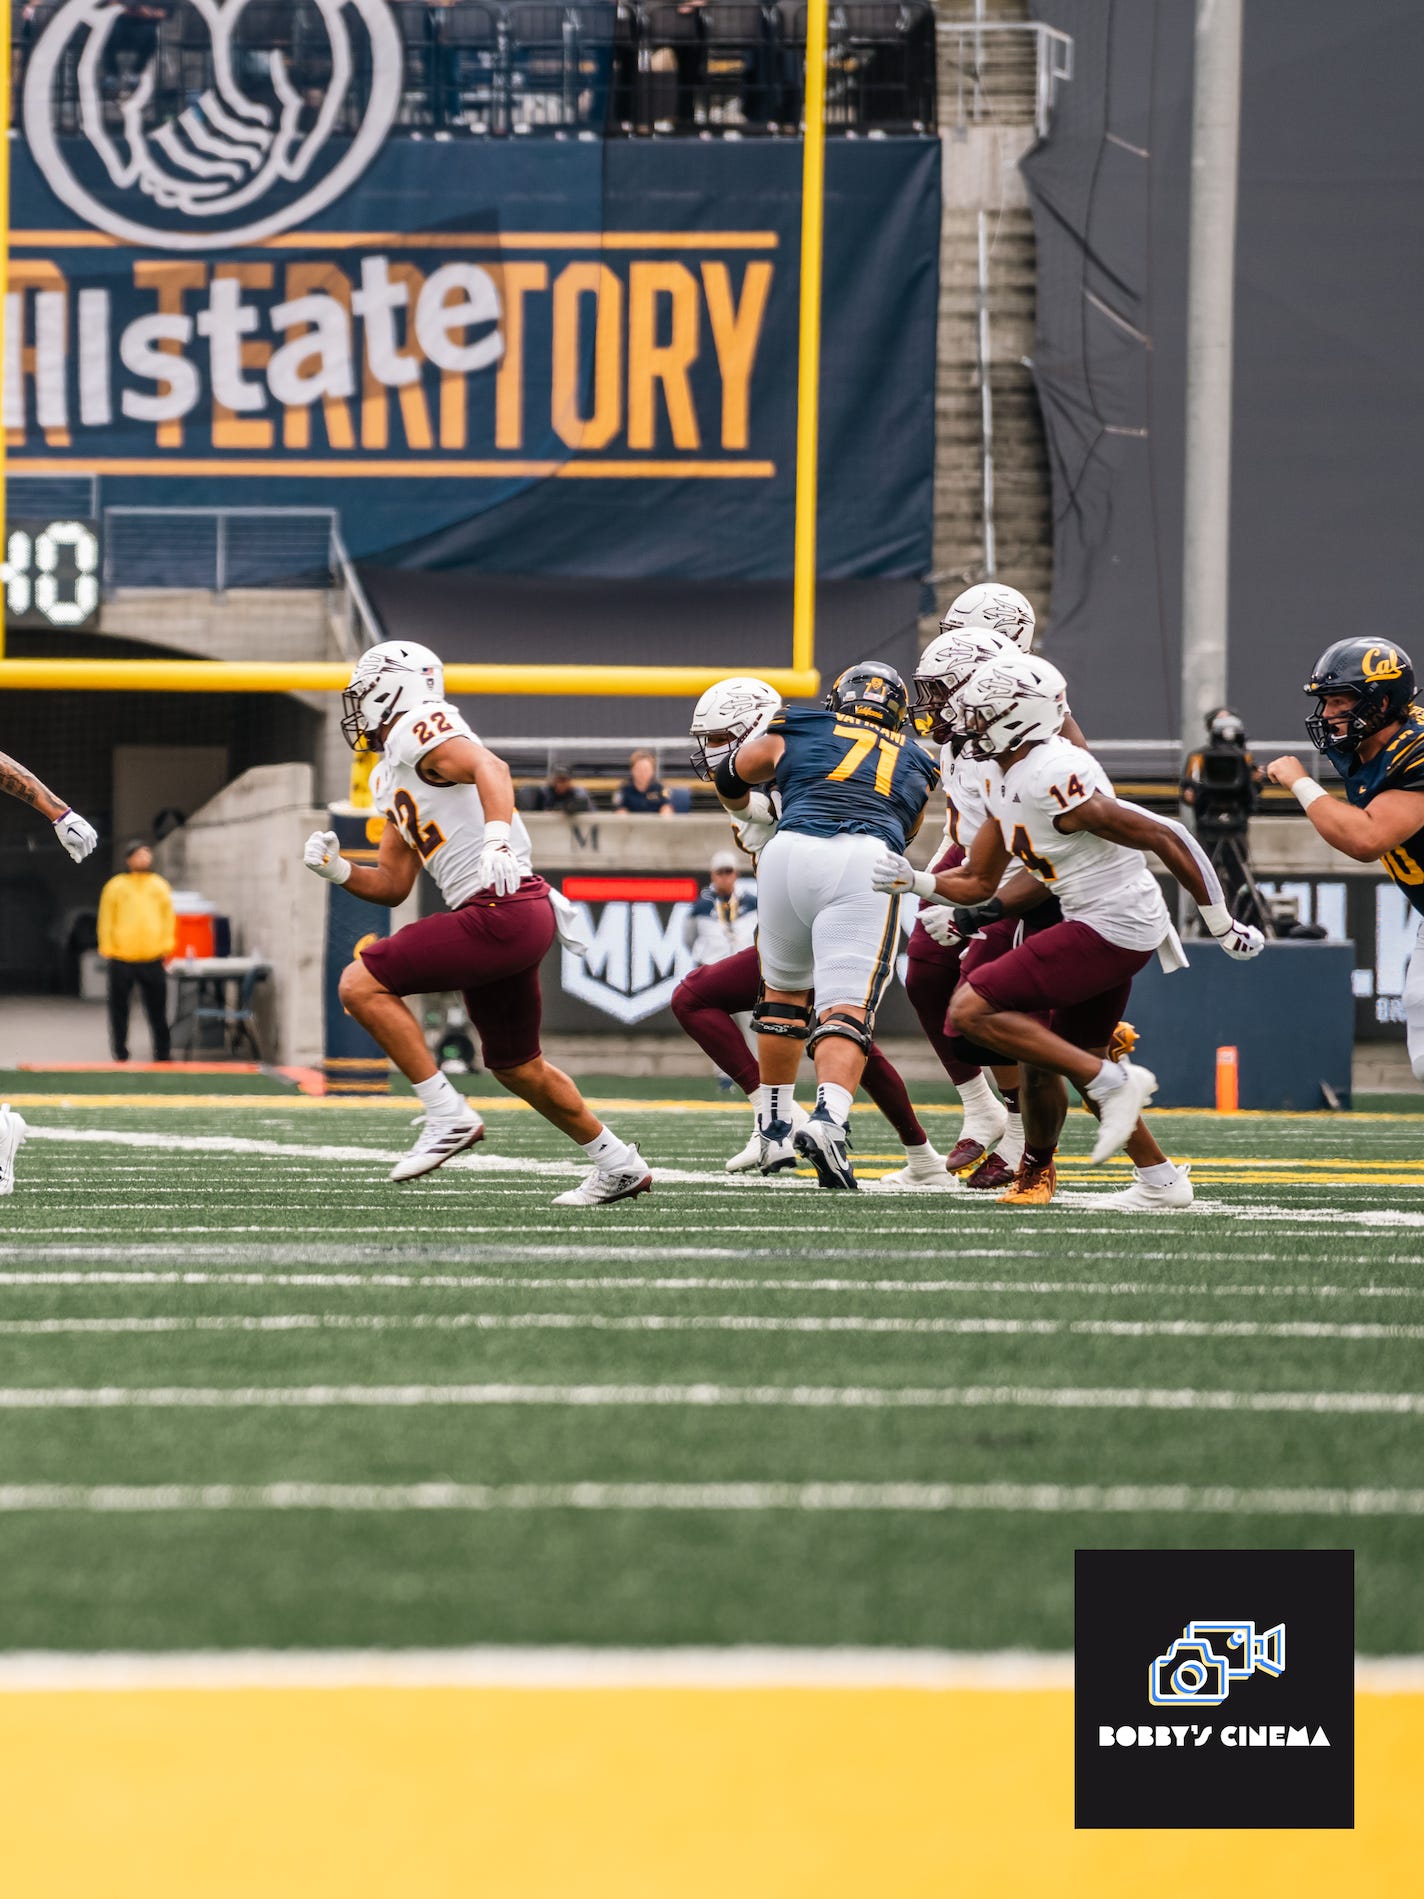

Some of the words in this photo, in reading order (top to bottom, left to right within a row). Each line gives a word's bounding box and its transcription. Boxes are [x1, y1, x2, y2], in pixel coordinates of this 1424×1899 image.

[1361, 647, 1402, 683] Cal
[412, 711, 454, 746] 22
[825, 724, 901, 797] 71
[1049, 773, 1086, 809] 14
[571, 825, 599, 851] M
